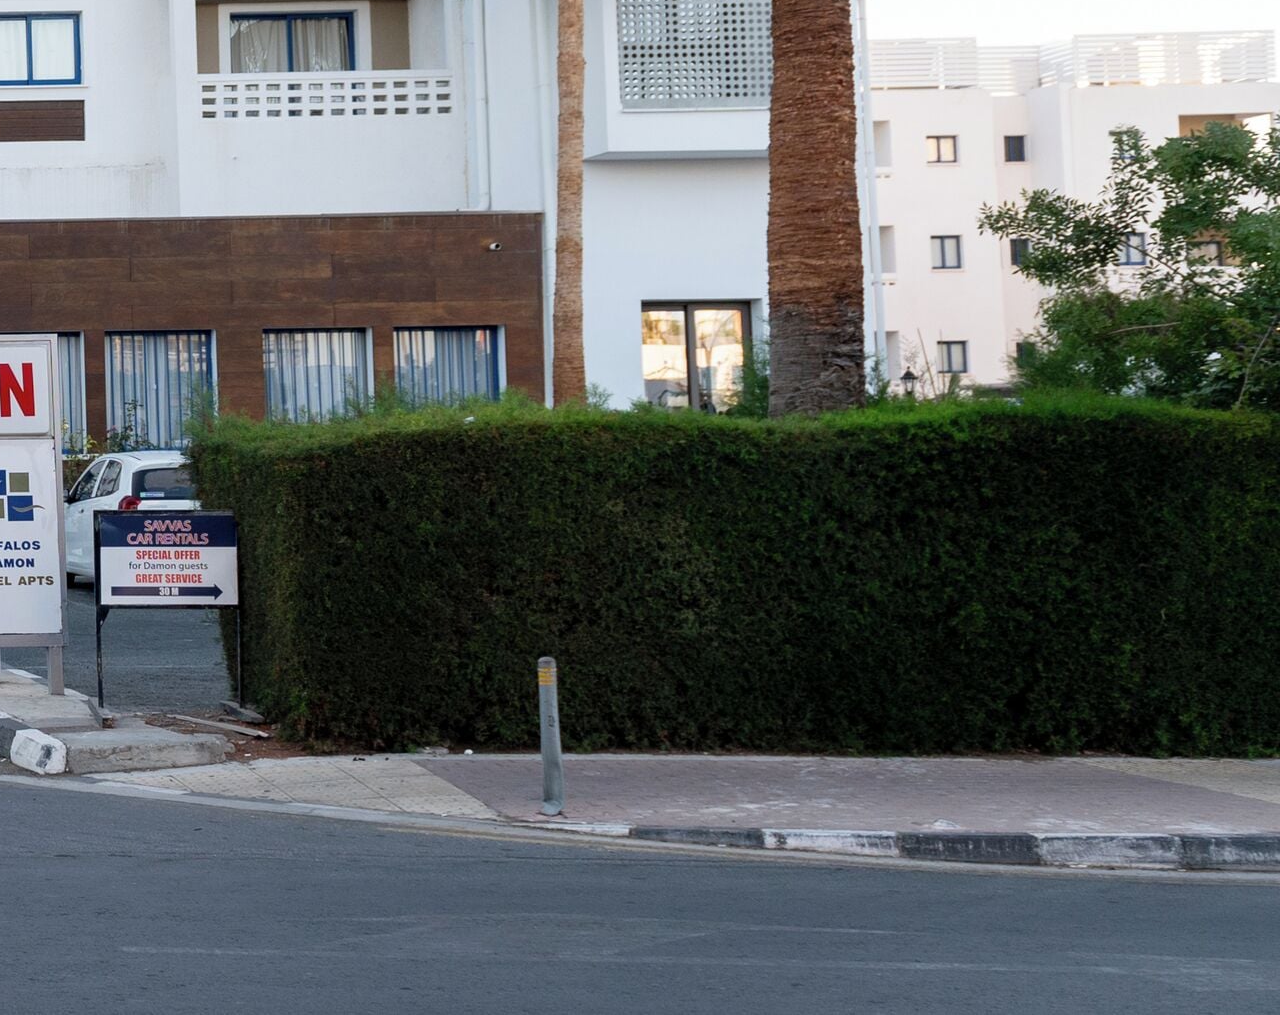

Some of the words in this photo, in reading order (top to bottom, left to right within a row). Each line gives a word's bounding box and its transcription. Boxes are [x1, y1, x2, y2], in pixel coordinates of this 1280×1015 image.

[143, 519, 192, 532] SAVVAS
[127, 533, 153, 545] CAR
[155, 532, 209, 545] RENTALS
[136, 550, 172, 560] SPECIAL
[174, 550, 200, 560] OFFER
[129, 561, 142, 570] for
[144, 561, 177, 570] Damon
[178, 562, 209, 572] guests
[18, 576, 54, 586] APTS
[135, 574, 164, 584] GREAT
[165, 574, 203, 584] SERVICE
[159, 587, 170, 596] 30
[171, 587, 179, 596] M
